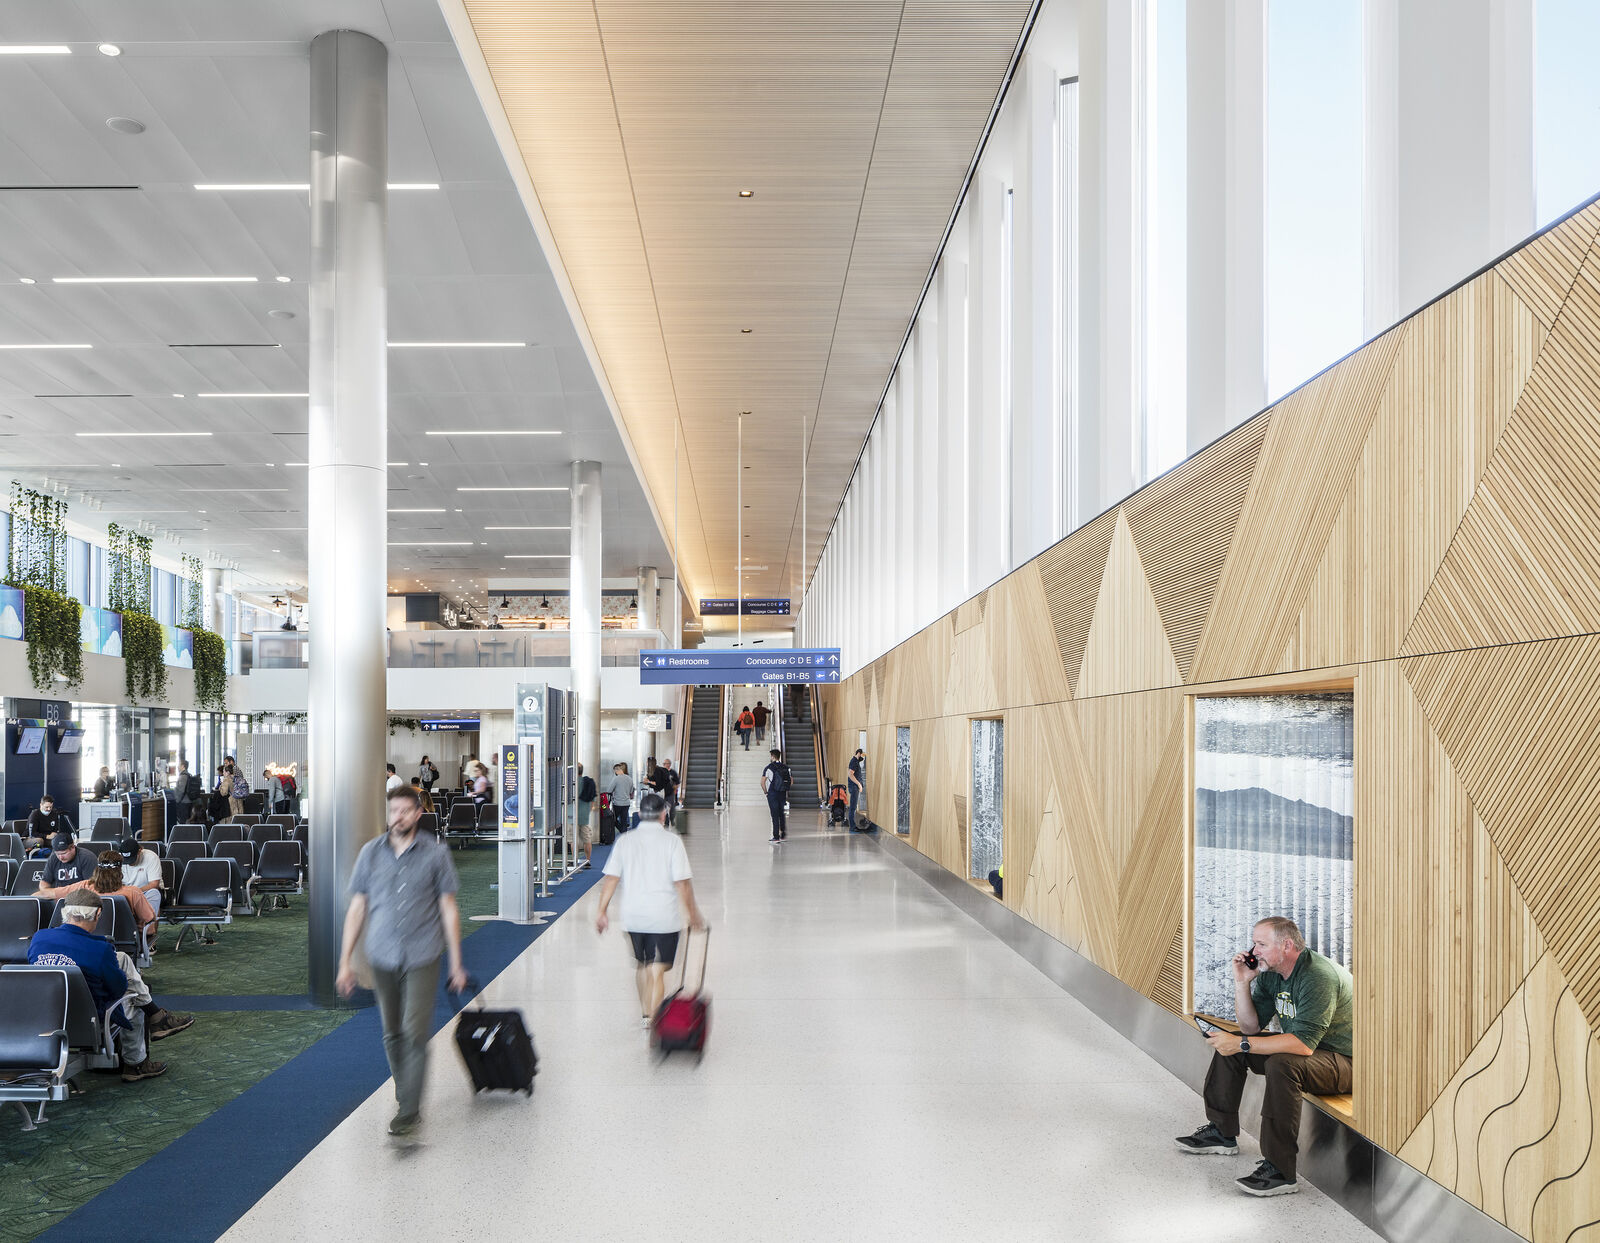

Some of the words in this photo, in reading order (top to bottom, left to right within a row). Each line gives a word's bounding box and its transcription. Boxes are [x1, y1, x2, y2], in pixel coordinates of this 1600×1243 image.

[669, 657, 709, 666] Restrooms
[746, 656, 788, 665] Concourse
[789, 656, 796, 665] C
[798, 656, 804, 665] D
[806, 656, 812, 664] E
[762, 672, 785, 681] Gates
[786, 672, 810, 680] B1-B5
[46, 703, 59, 720] B6
[245, 745, 253, 761] BAR
